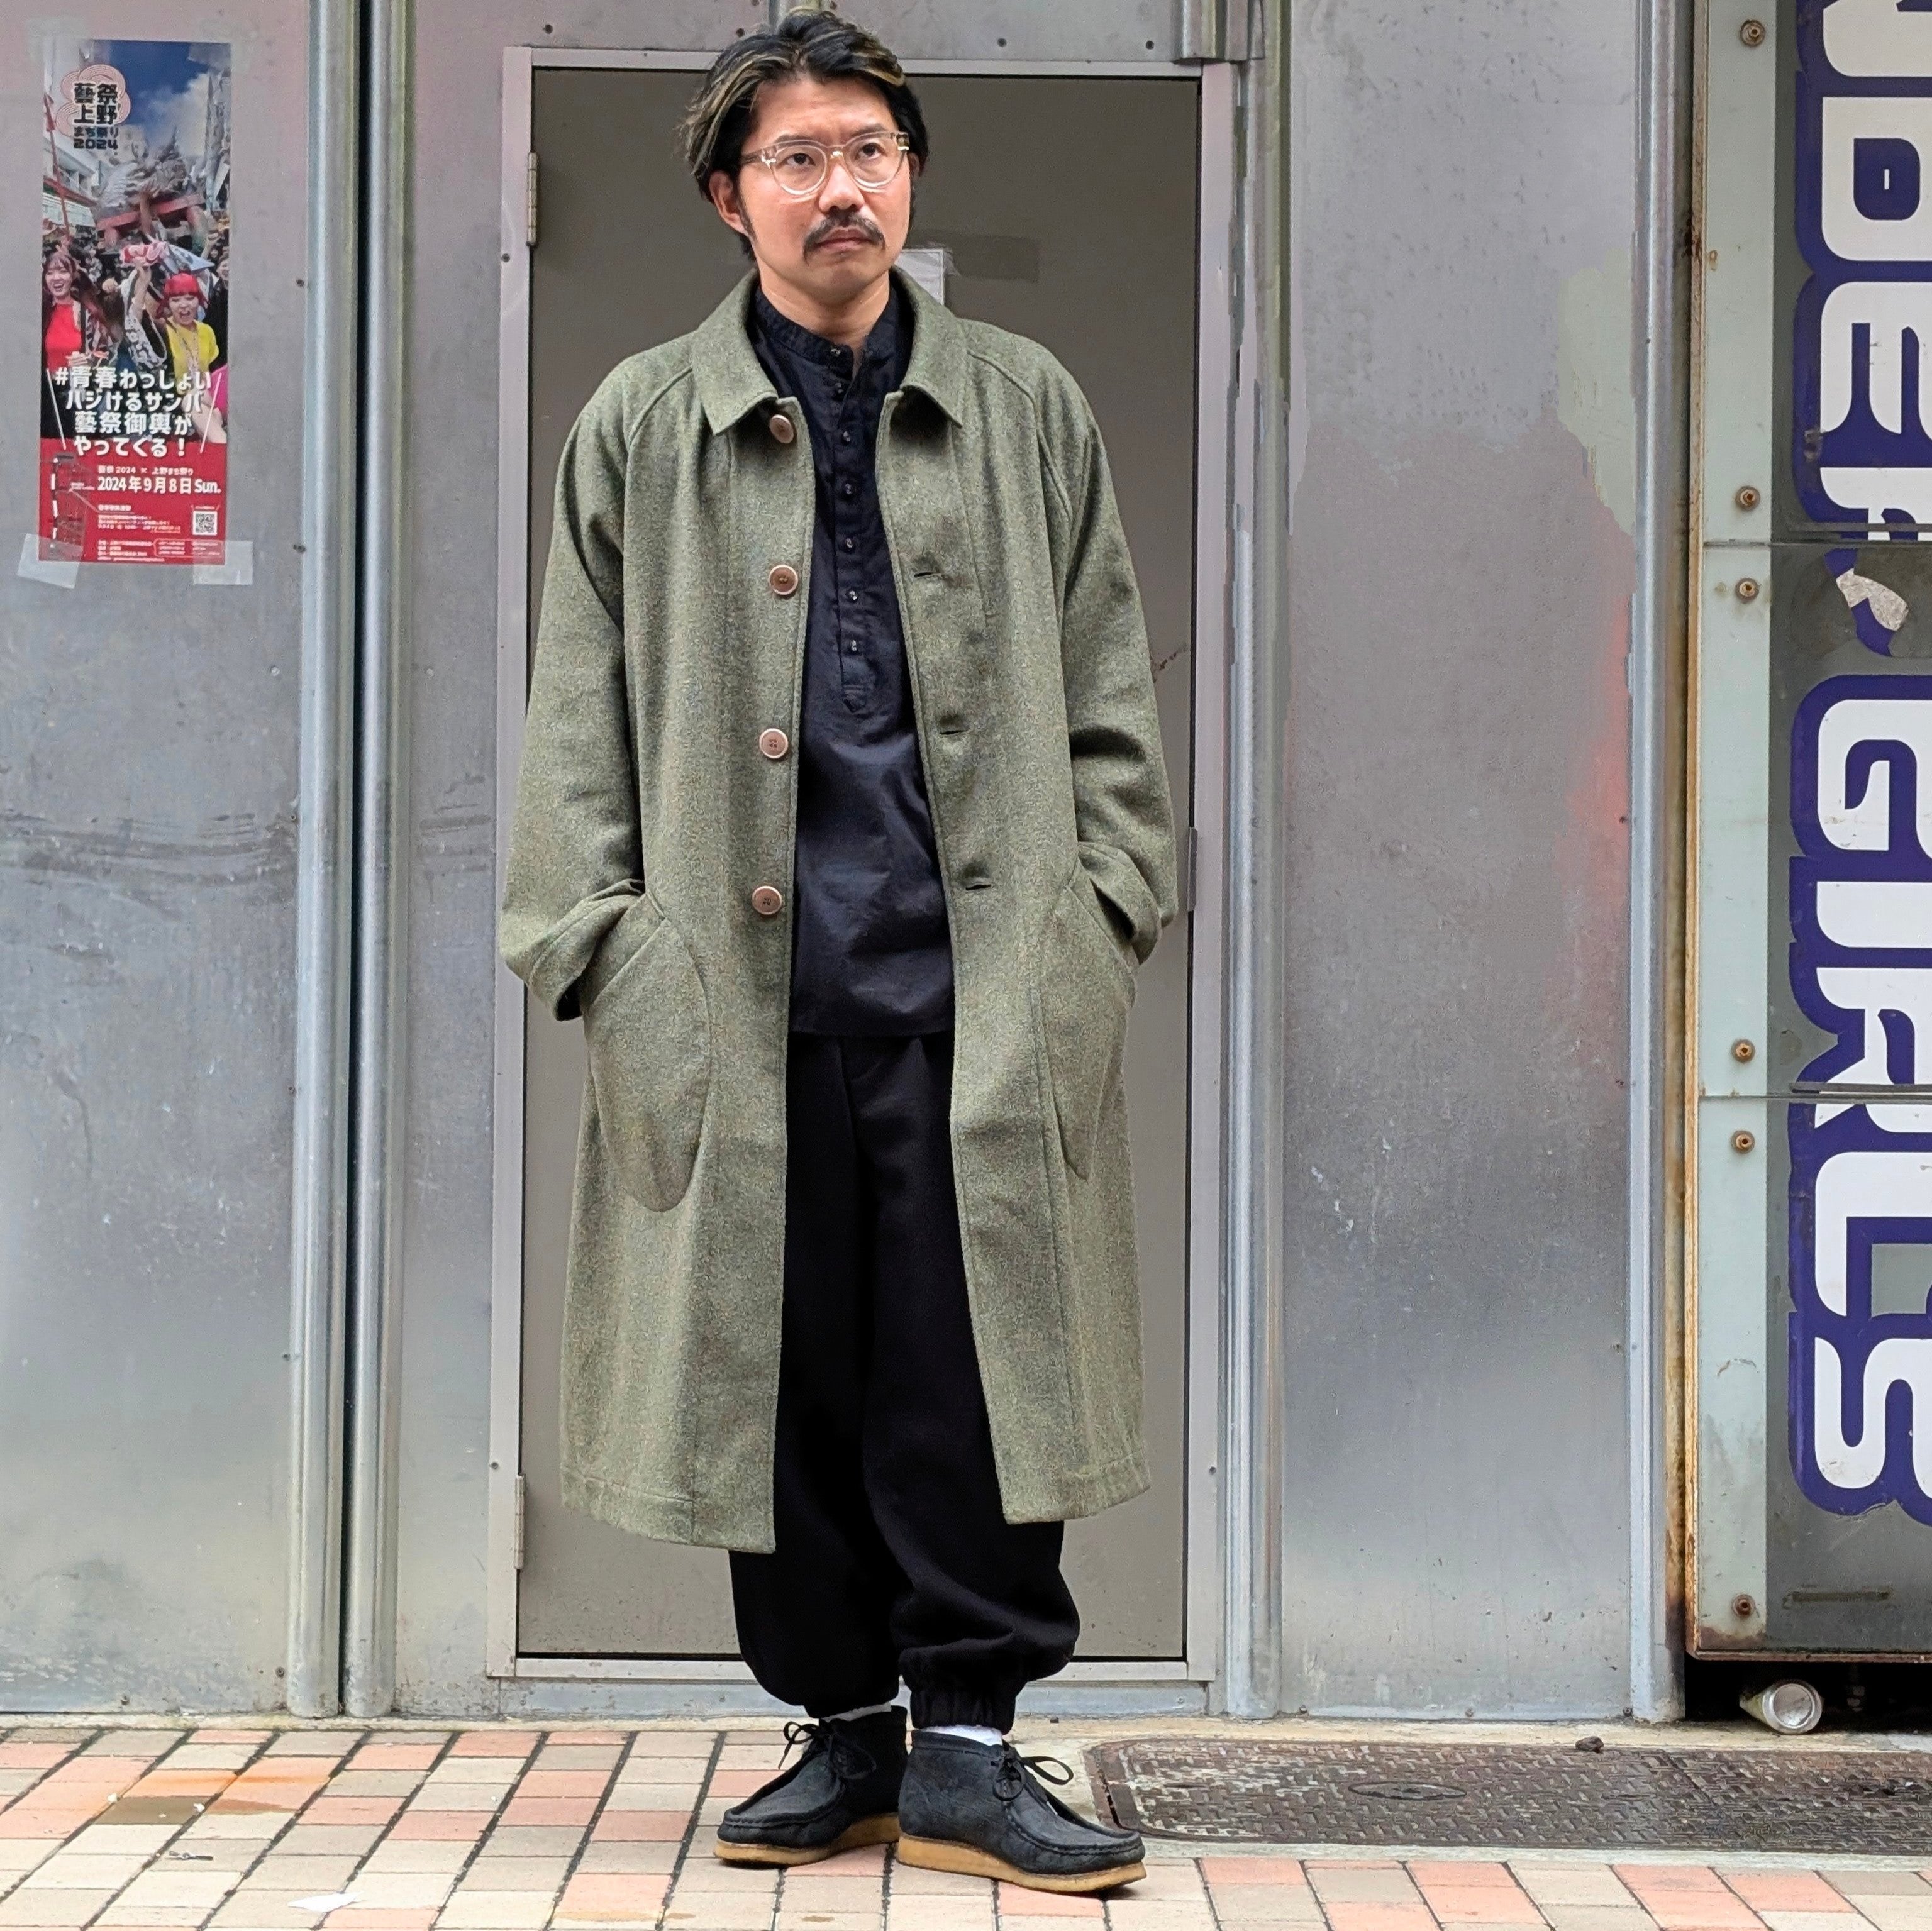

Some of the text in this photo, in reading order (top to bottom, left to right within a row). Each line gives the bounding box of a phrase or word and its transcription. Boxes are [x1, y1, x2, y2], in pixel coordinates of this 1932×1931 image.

[74, 104, 118, 124] 上野
[74, 138, 118, 150] 2024
[66, 390, 204, 412] ハジけるサンバ
[194, 479, 221, 494] Sun.
[1815, 699, 1932, 1500] GIRLS
